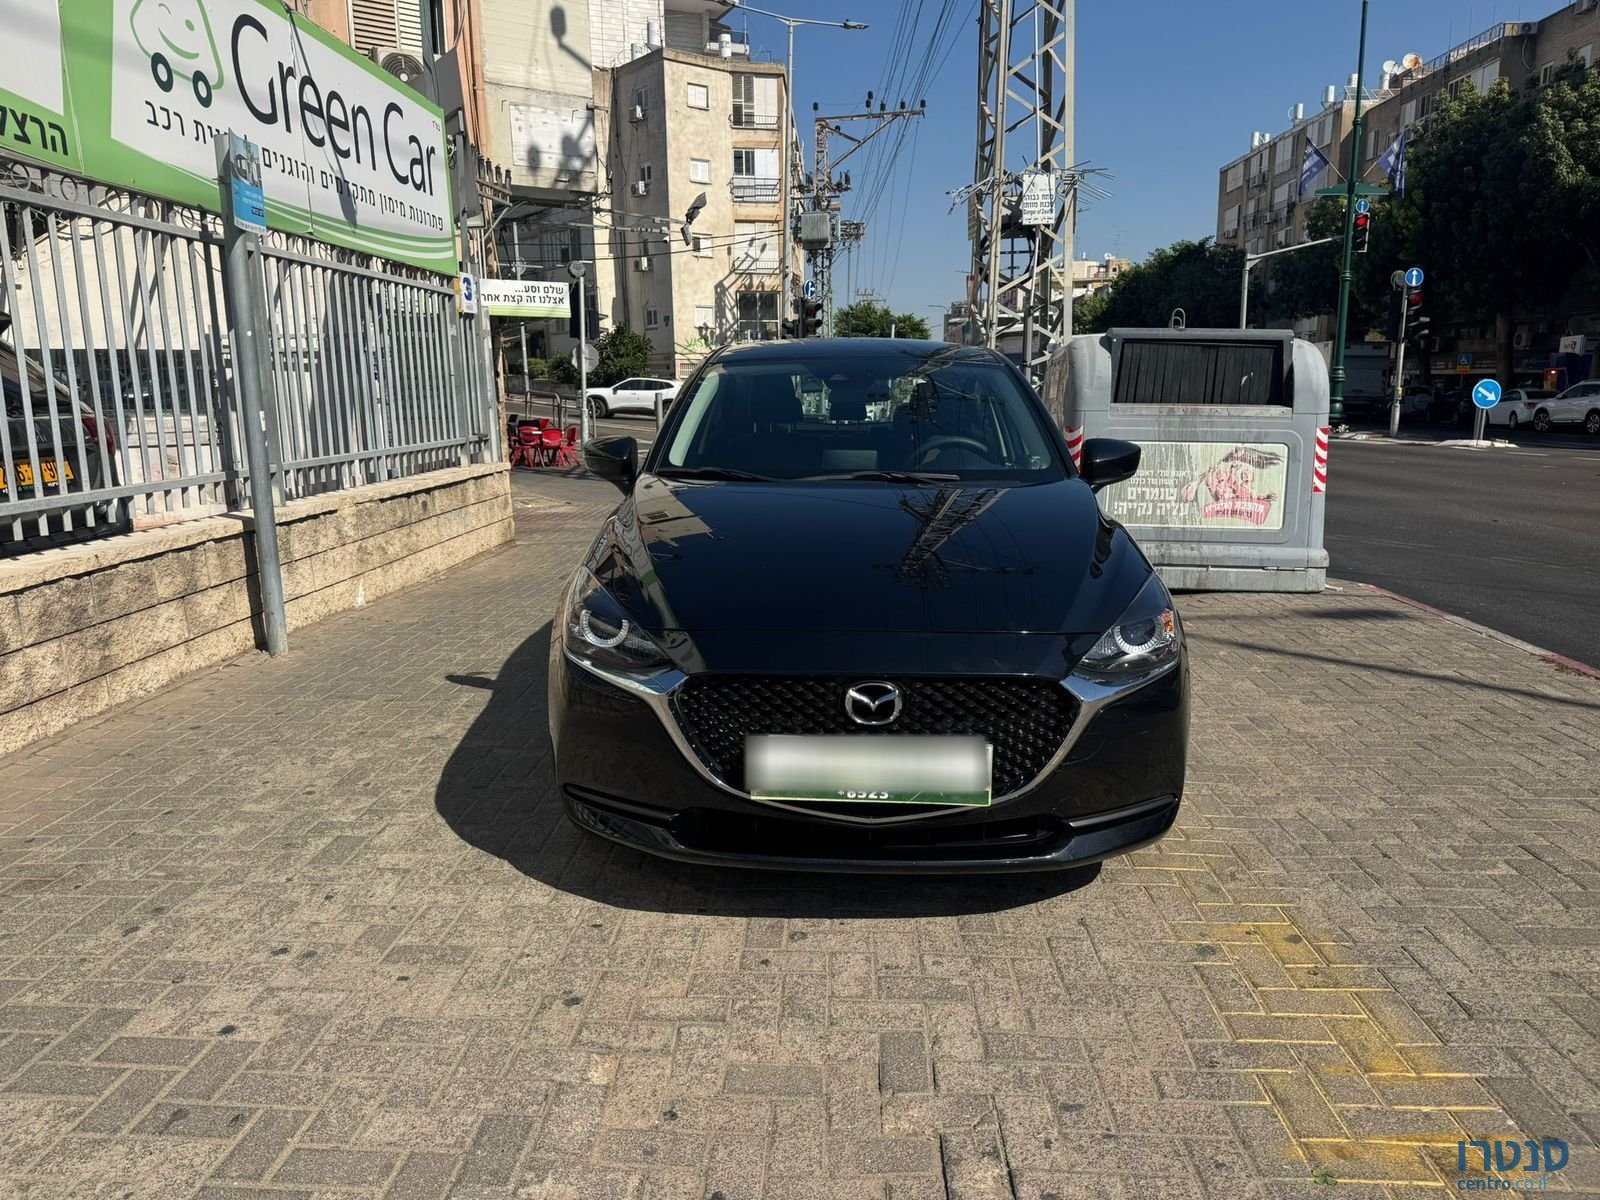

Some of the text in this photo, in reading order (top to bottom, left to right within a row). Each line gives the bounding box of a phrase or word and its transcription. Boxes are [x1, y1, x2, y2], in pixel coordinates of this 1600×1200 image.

[231, 13, 436, 196] Green Car
[145, 100, 185, 136] רכב
[262, 147, 315, 185] והוגנים
[320, 169, 376, 206] מתקדמים
[379, 193, 406, 217] מימון
[409, 204, 444, 231] פתרונות
[503, 294, 523, 304] קצת
[526, 295, 537, 303] זה
[539, 294, 565, 304] אצלנו
[543, 284, 564, 294] שלם
[1127, 486, 1178, 501] שומרים
[1114, 500, 1189, 517] עליה נקייה!
